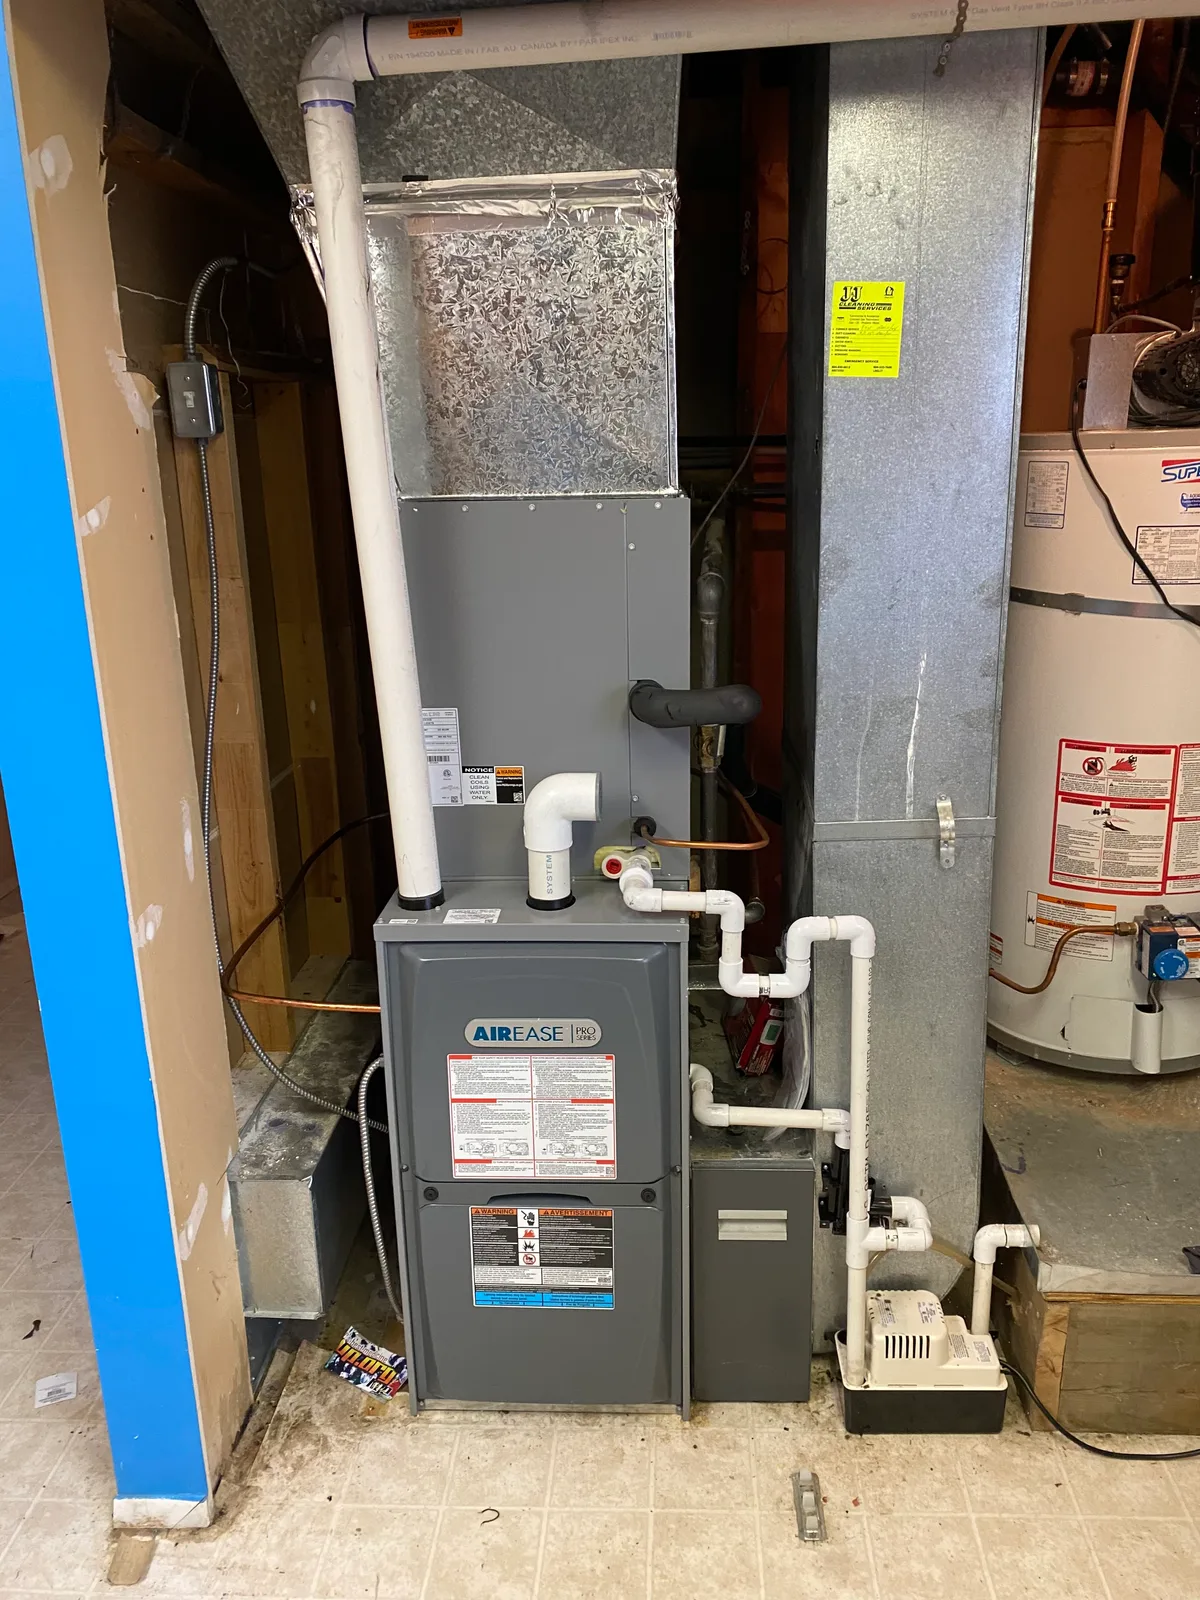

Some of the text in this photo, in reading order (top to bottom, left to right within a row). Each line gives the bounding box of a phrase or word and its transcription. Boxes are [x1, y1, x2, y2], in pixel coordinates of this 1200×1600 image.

[437, 48, 463, 57] MADE
[520, 41, 558, 51] CANADA
[560, 40, 571, 48] BY
[473, 1026, 596, 1042] AIREASE PRO
